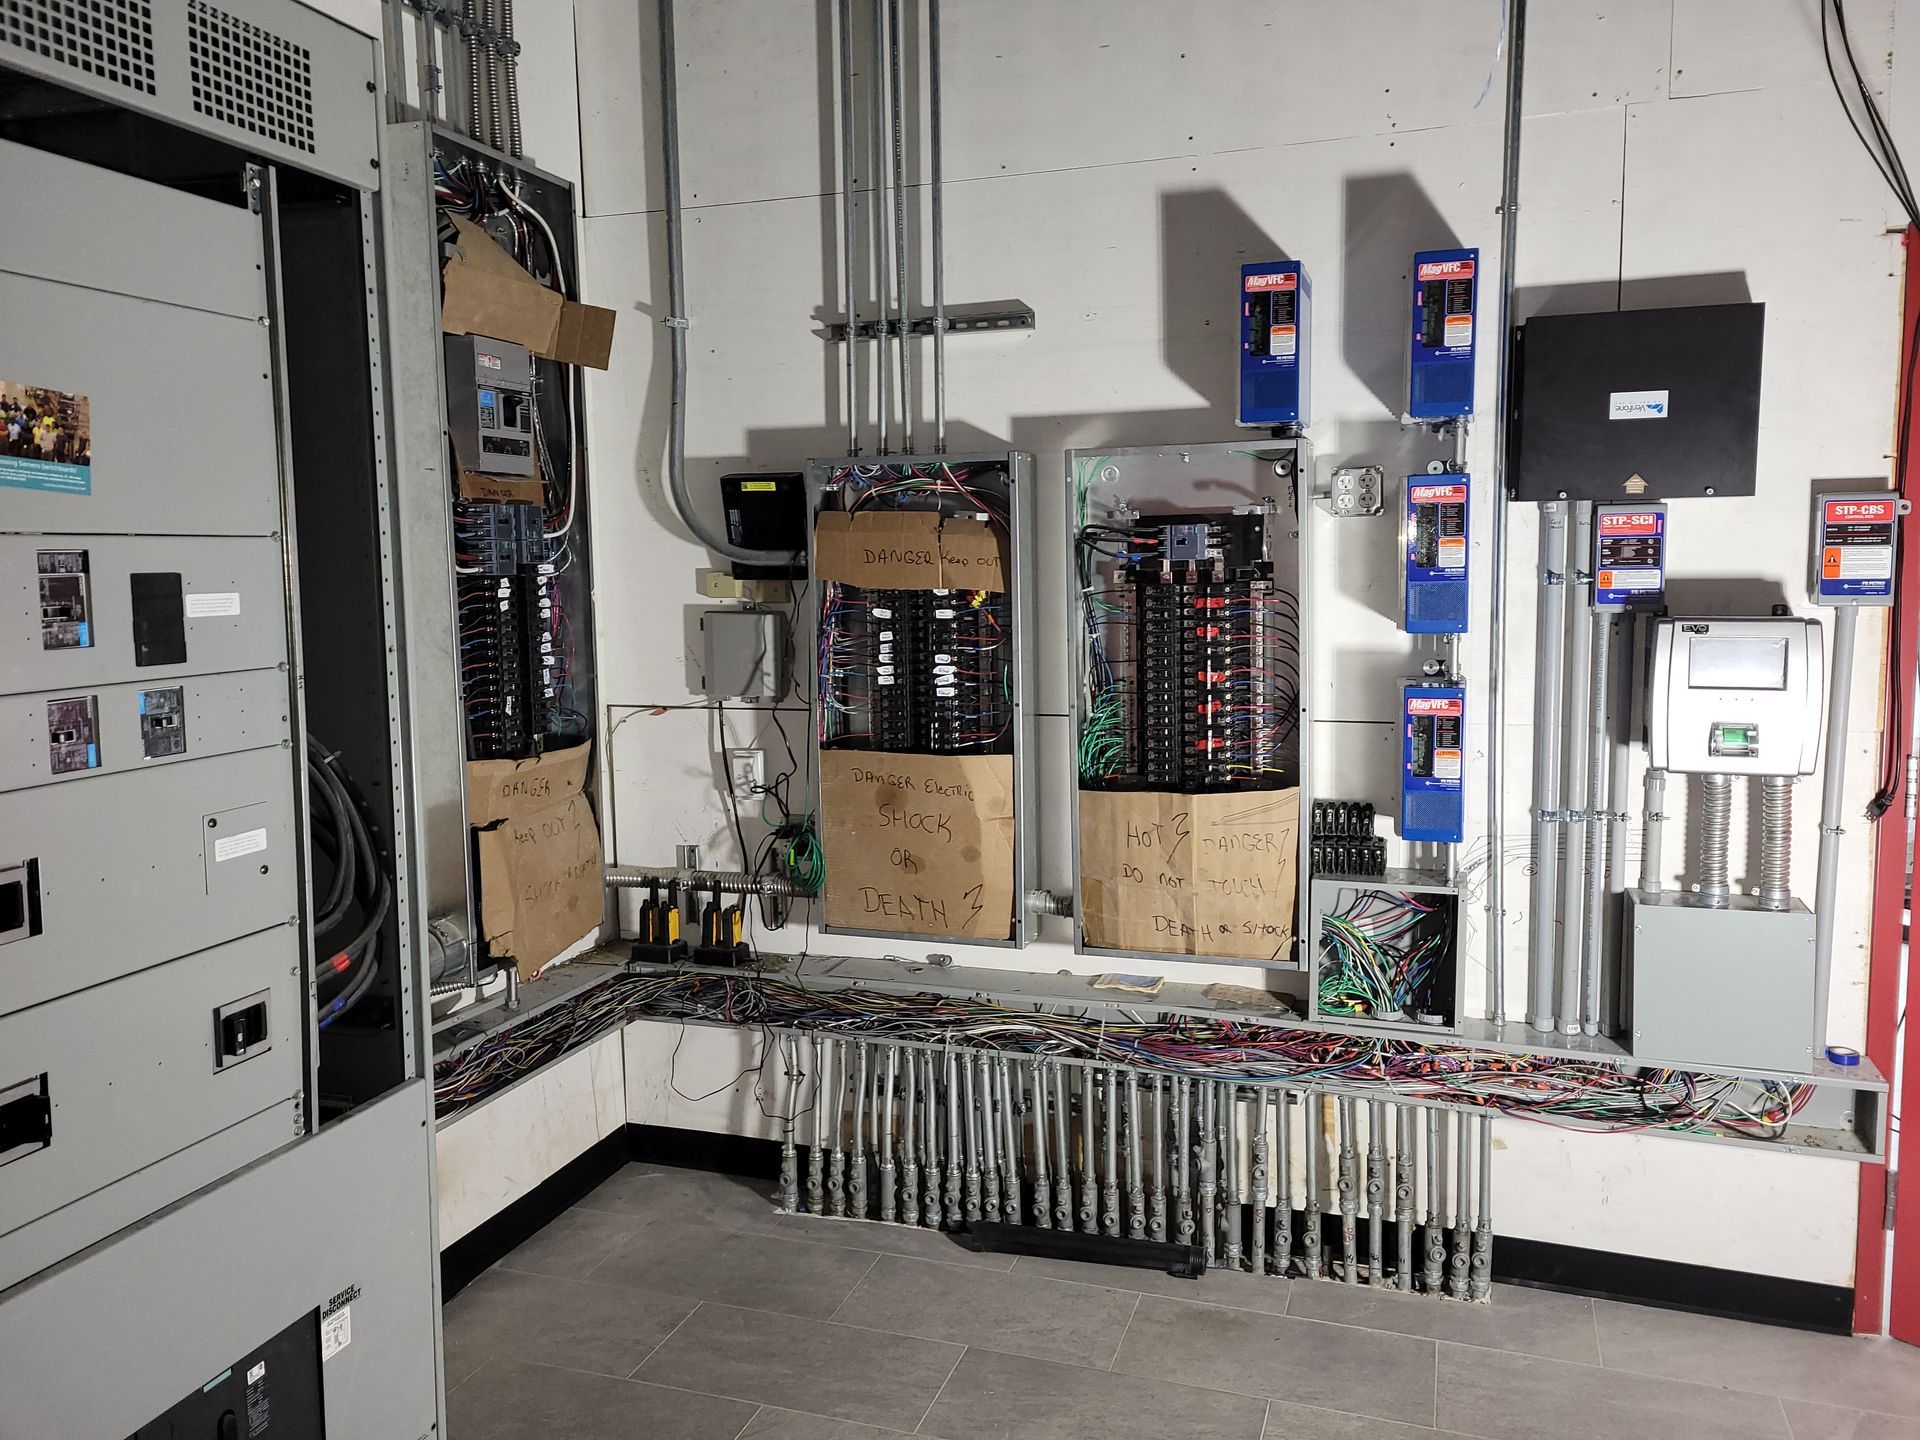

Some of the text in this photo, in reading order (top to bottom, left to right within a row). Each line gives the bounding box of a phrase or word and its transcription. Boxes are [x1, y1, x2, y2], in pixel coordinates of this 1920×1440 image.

[1421, 262, 1460, 275] MagVFC
[1247, 274, 1285, 287] MagVFC
[1413, 486, 1453, 498] MagVFC
[1602, 515, 1654, 525] STP-SCI
[1835, 505, 1885, 515] STP-CBS
[864, 549, 934, 565] DANGER
[1683, 624, 1707, 632] EVO
[1410, 699, 1449, 710] MagVFC
[502, 777, 550, 798] DANGER
[878, 803, 952, 843] SHOCK
[1126, 821, 1165, 849] HOT
[890, 848, 918, 875] OR
[1122, 863, 1144, 883] DO
[858, 886, 948, 928] DEATH
[1152, 915, 1214, 943] DEATH
[322, 1288, 362, 1320] DISCONNECT
[328, 1283, 355, 1307] SERVICE
